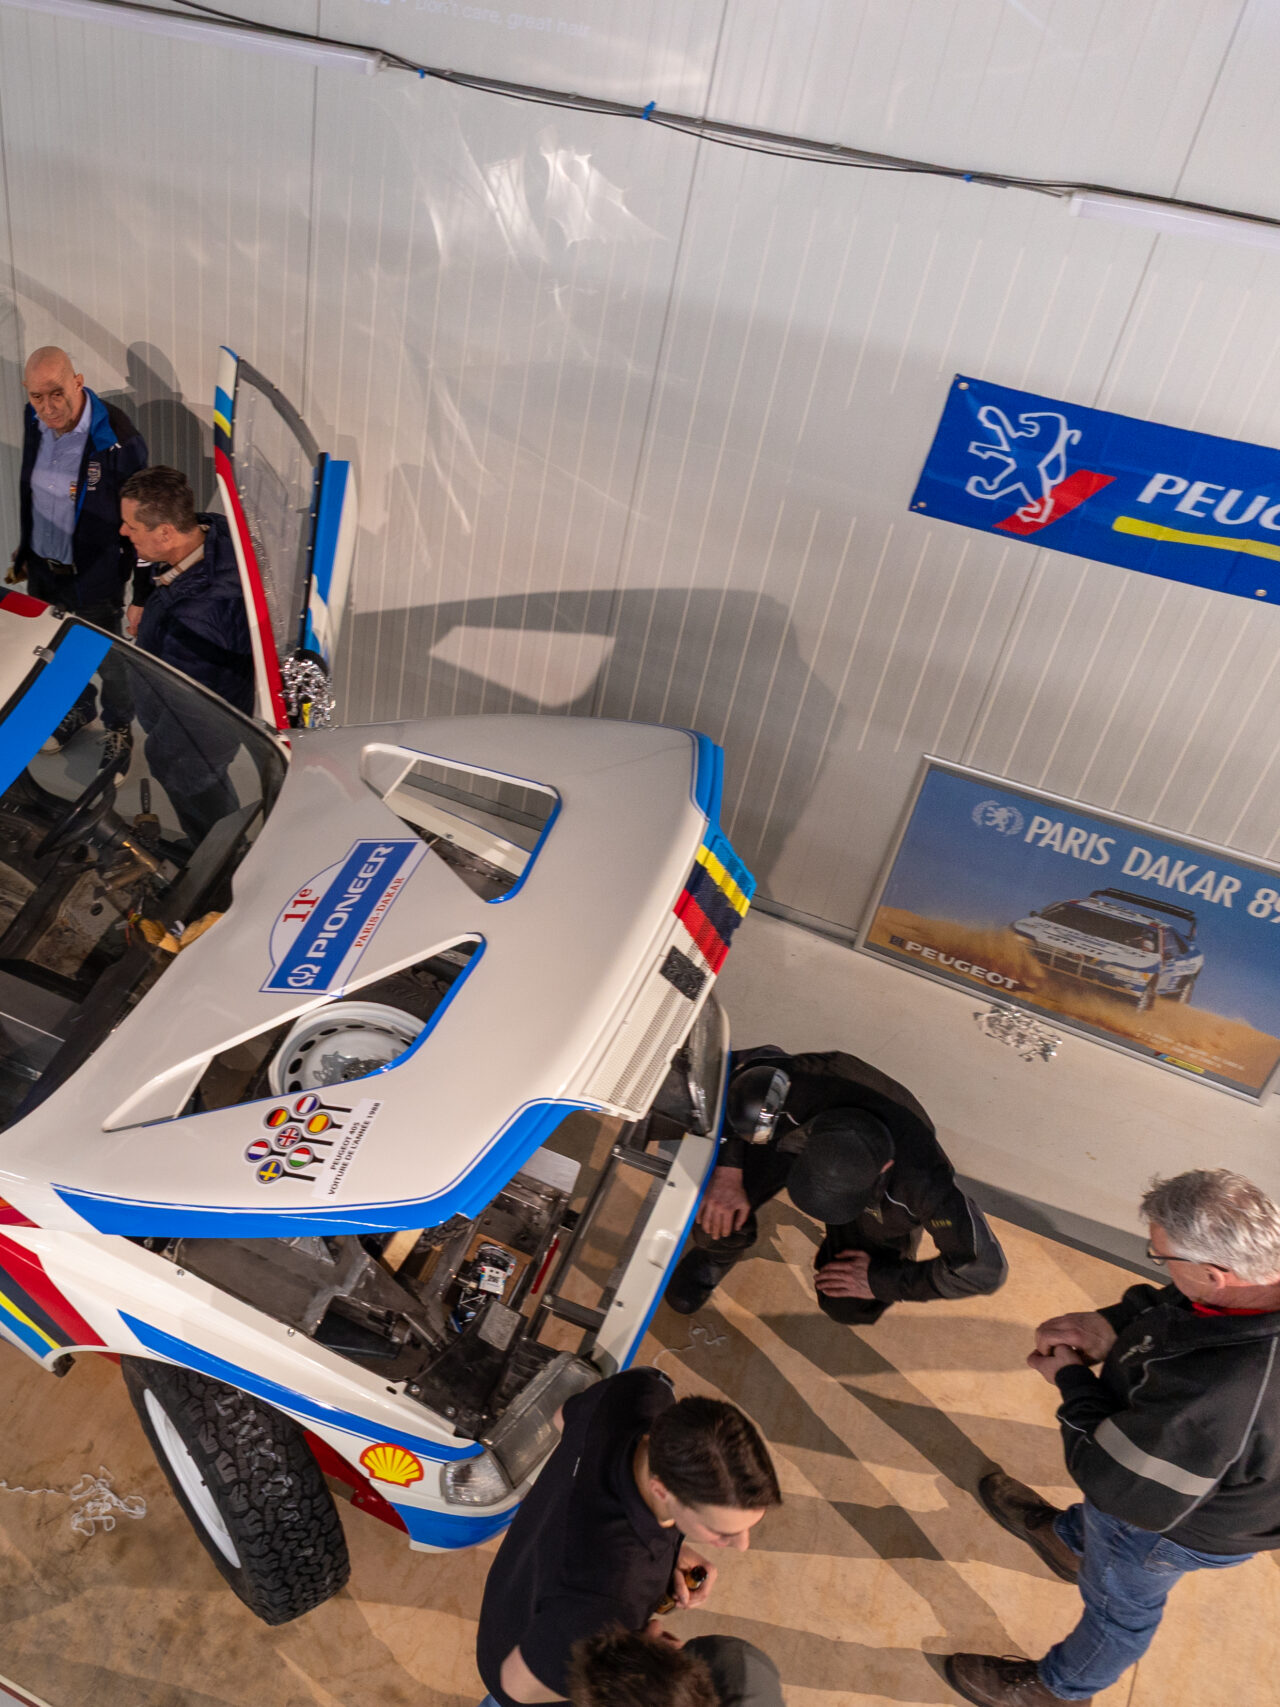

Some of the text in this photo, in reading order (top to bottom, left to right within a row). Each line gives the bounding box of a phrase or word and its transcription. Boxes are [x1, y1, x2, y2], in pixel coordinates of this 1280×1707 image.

[306, 845, 396, 958] PIONEER
[1024, 815, 1116, 866] PARIS
[1121, 846, 1242, 908] DAKAR
[354, 877, 405, 947] PARIS-DAKAR
[905, 941, 1020, 989] PEUGEOT
[327, 1162, 349, 1195] VOITURE
[344, 1150, 355, 1161] DE
[367, 1102, 381, 1118] 1988
[330, 1122, 360, 1170] PEUGEOT 405
